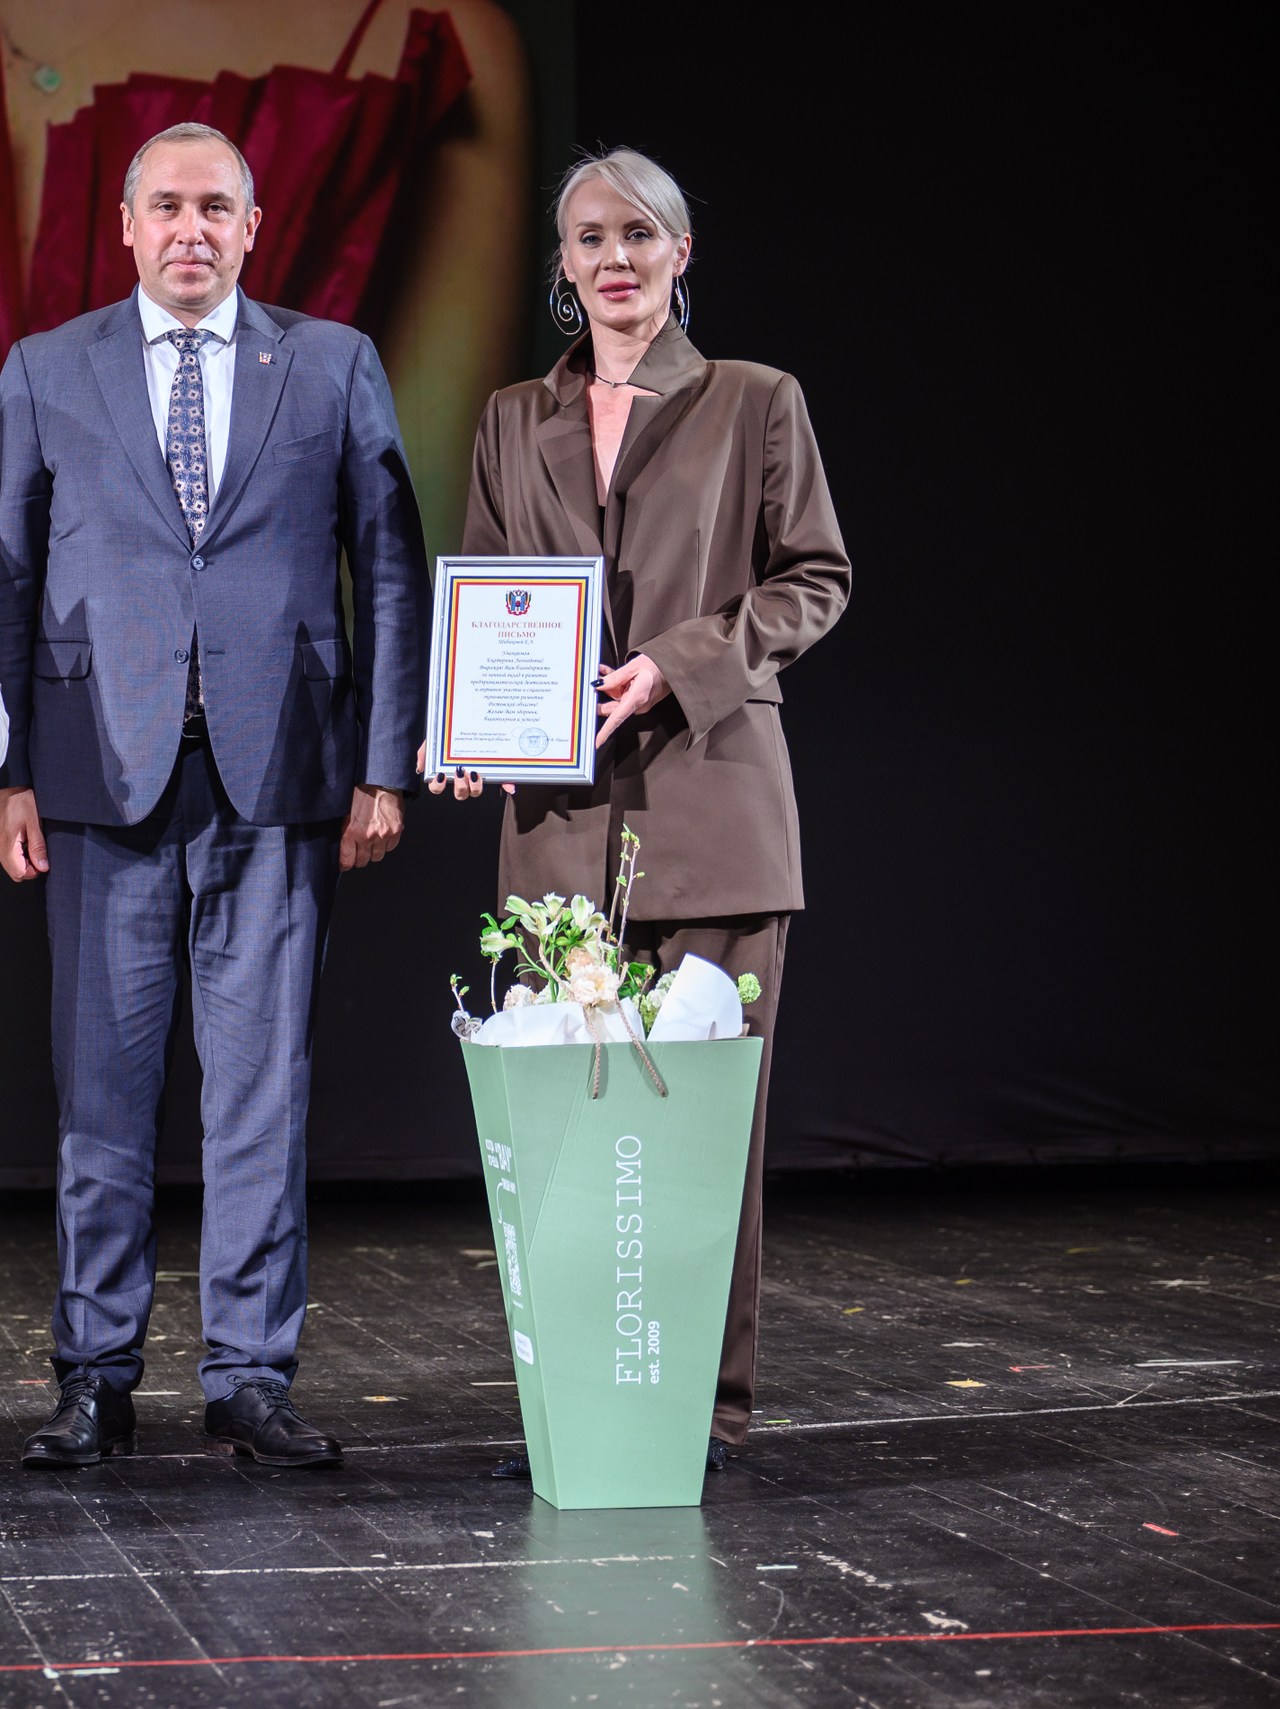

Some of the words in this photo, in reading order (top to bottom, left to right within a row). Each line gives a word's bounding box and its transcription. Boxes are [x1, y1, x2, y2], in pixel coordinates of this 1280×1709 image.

[615, 1135, 642, 1384] FLORISSIMO
[648, 1321, 660, 1354] 2009
[648, 1360, 659, 1384] est.
